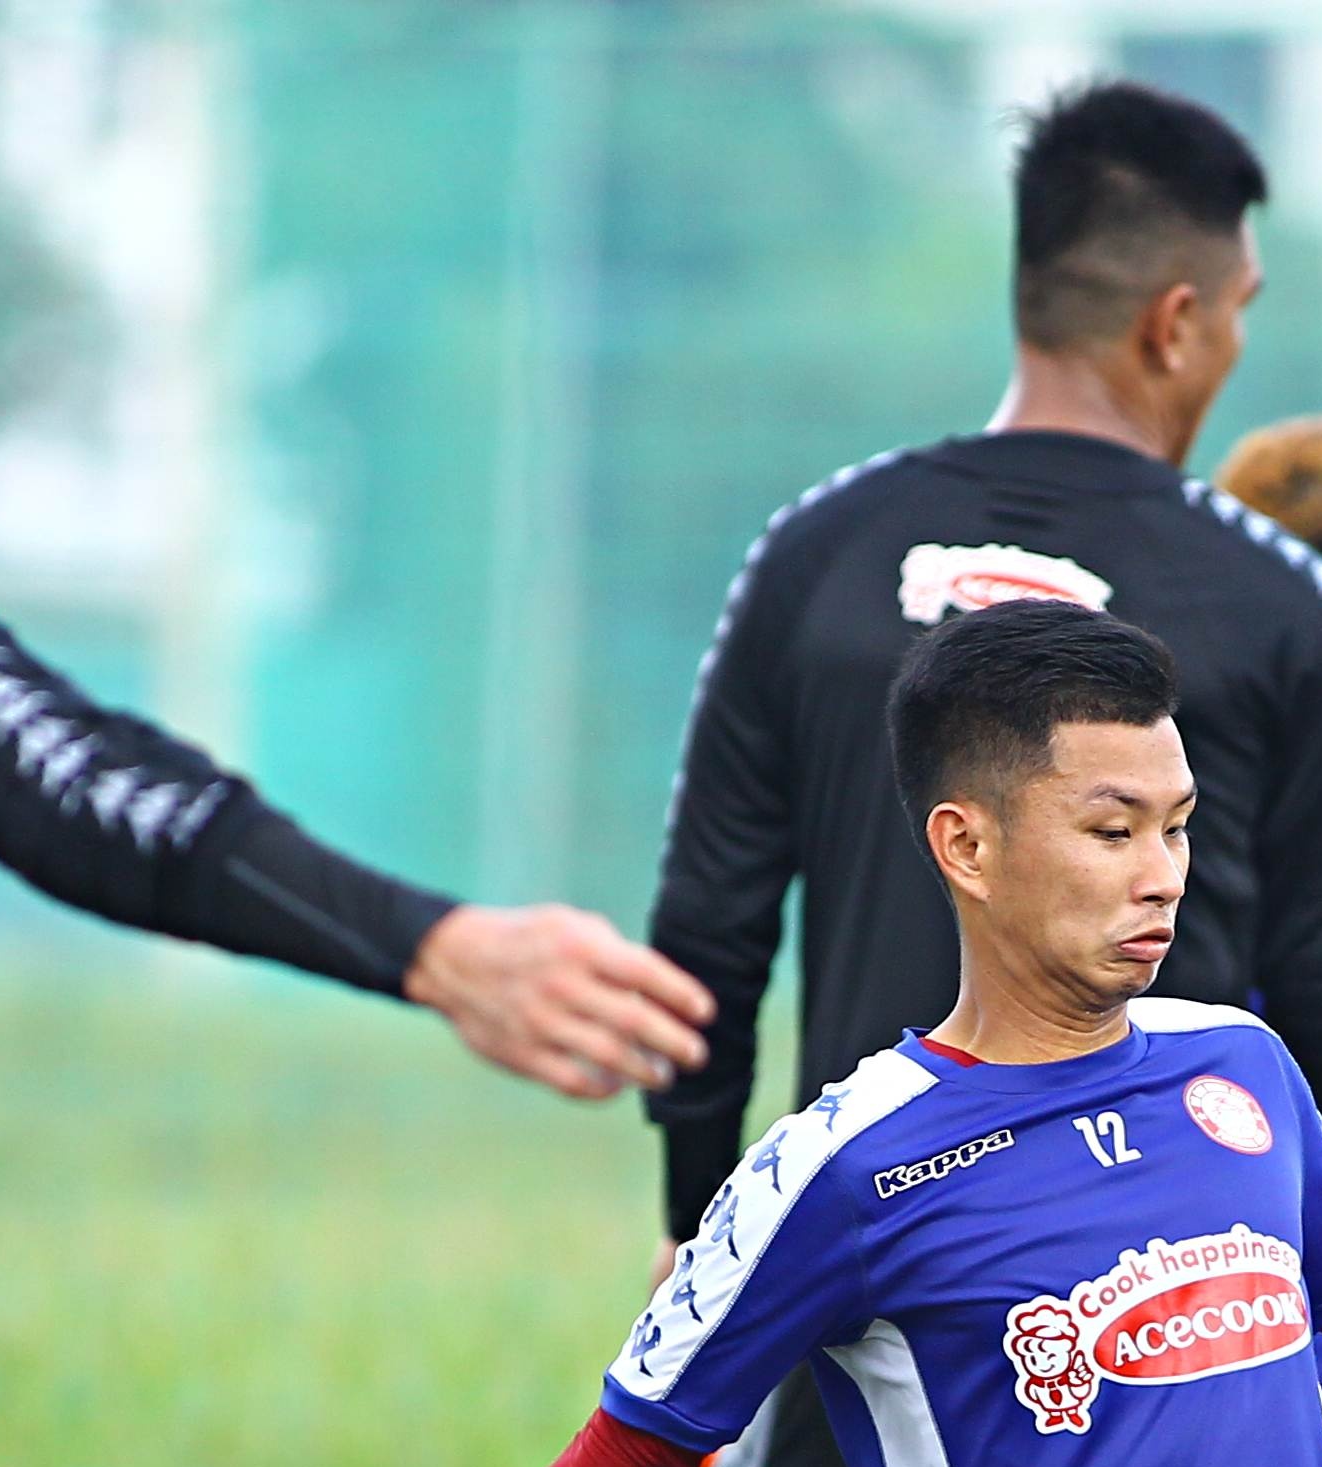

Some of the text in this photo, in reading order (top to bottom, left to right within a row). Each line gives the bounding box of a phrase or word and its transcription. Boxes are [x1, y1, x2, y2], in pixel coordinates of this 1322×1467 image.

[874, 1129, 1014, 1199] Kappa
[1072, 1111, 1142, 1168] 12
[1077, 1259, 1154, 1318] Cook
